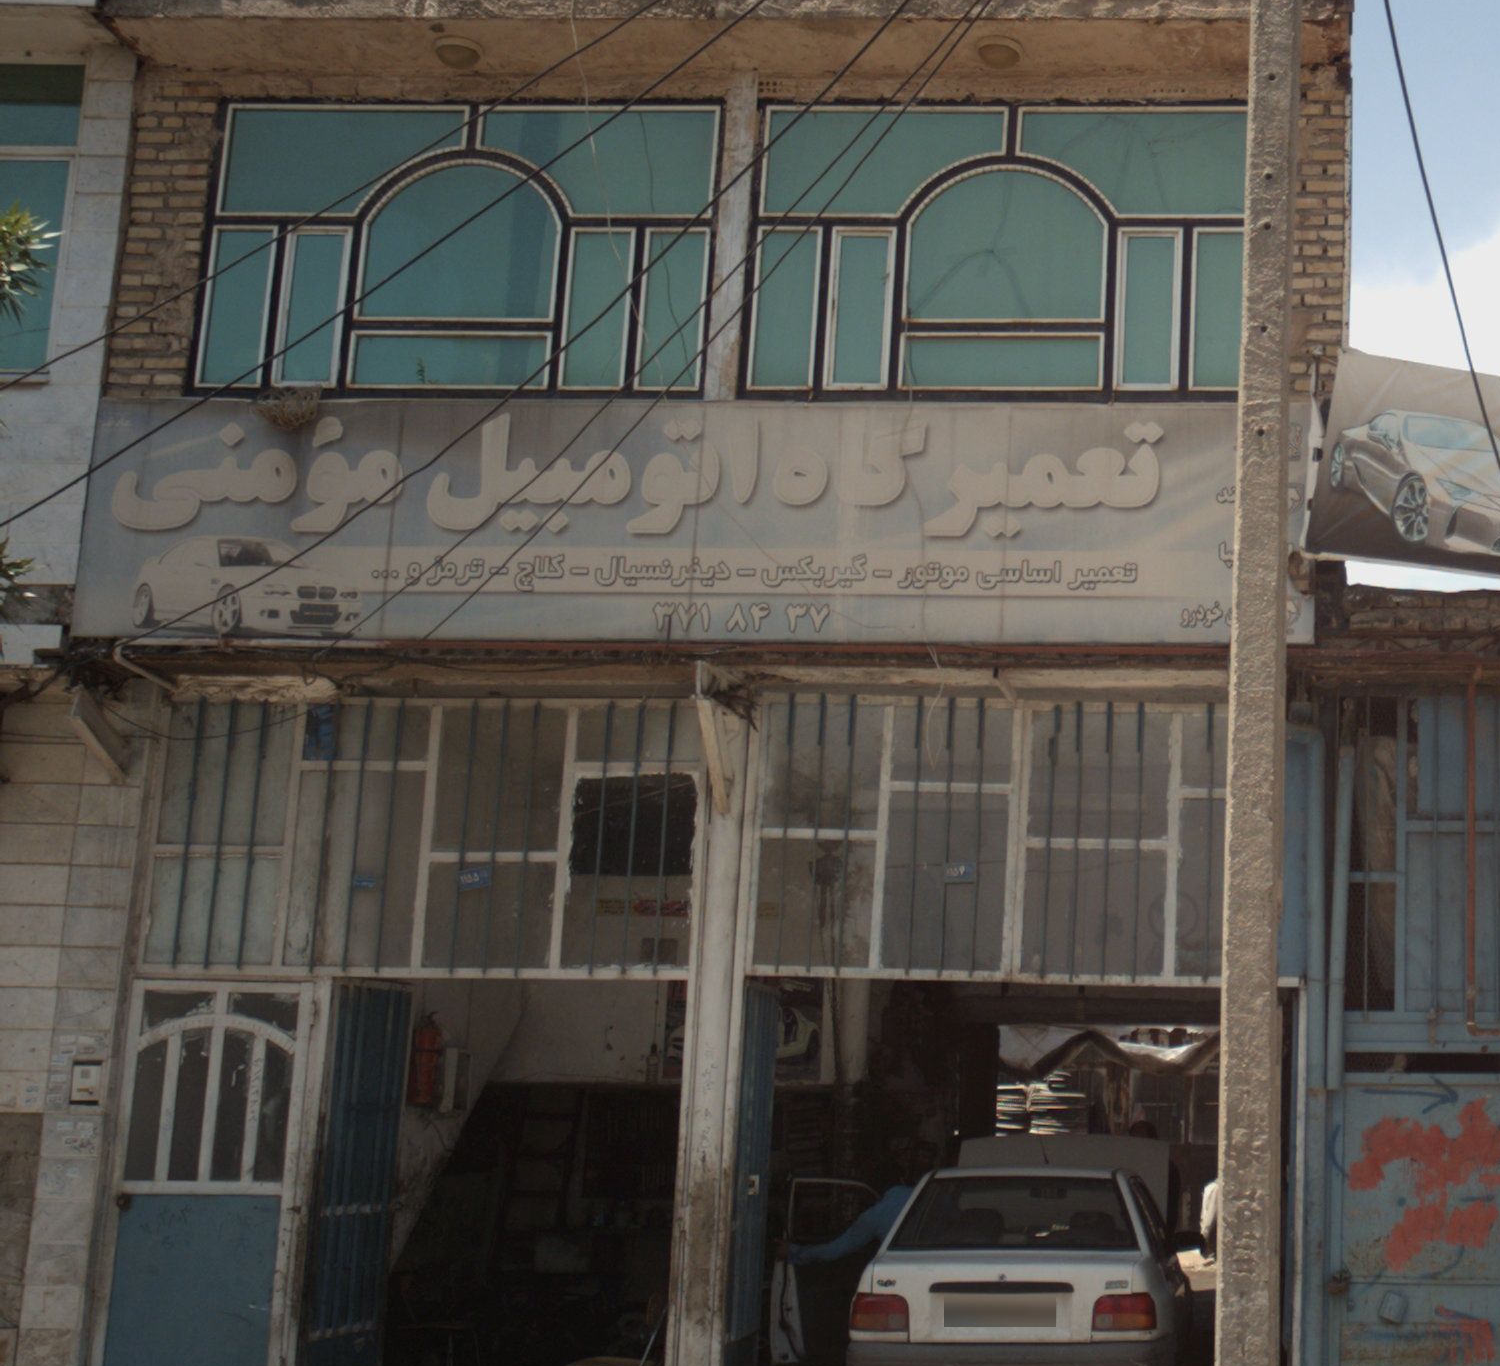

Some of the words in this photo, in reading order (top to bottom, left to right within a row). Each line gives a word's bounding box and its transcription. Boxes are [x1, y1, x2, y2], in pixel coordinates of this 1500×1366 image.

[427, 412, 760, 535] اتومبیل
[405, 562, 422, 585] و
[426, 554, 485, 585] ترمز
[514, 554, 565, 592] کلاچ
[594, 555, 731, 586] دیفرنسیال
[761, 553, 868, 588] گیربکس
[897, 562, 969, 589] موتور
[976, 559, 1061, 590] اساسی
[1067, 563, 1138, 590] تعمیر
[725, 602, 771, 633] ۸۴
[786, 602, 830, 633] ۳۷
